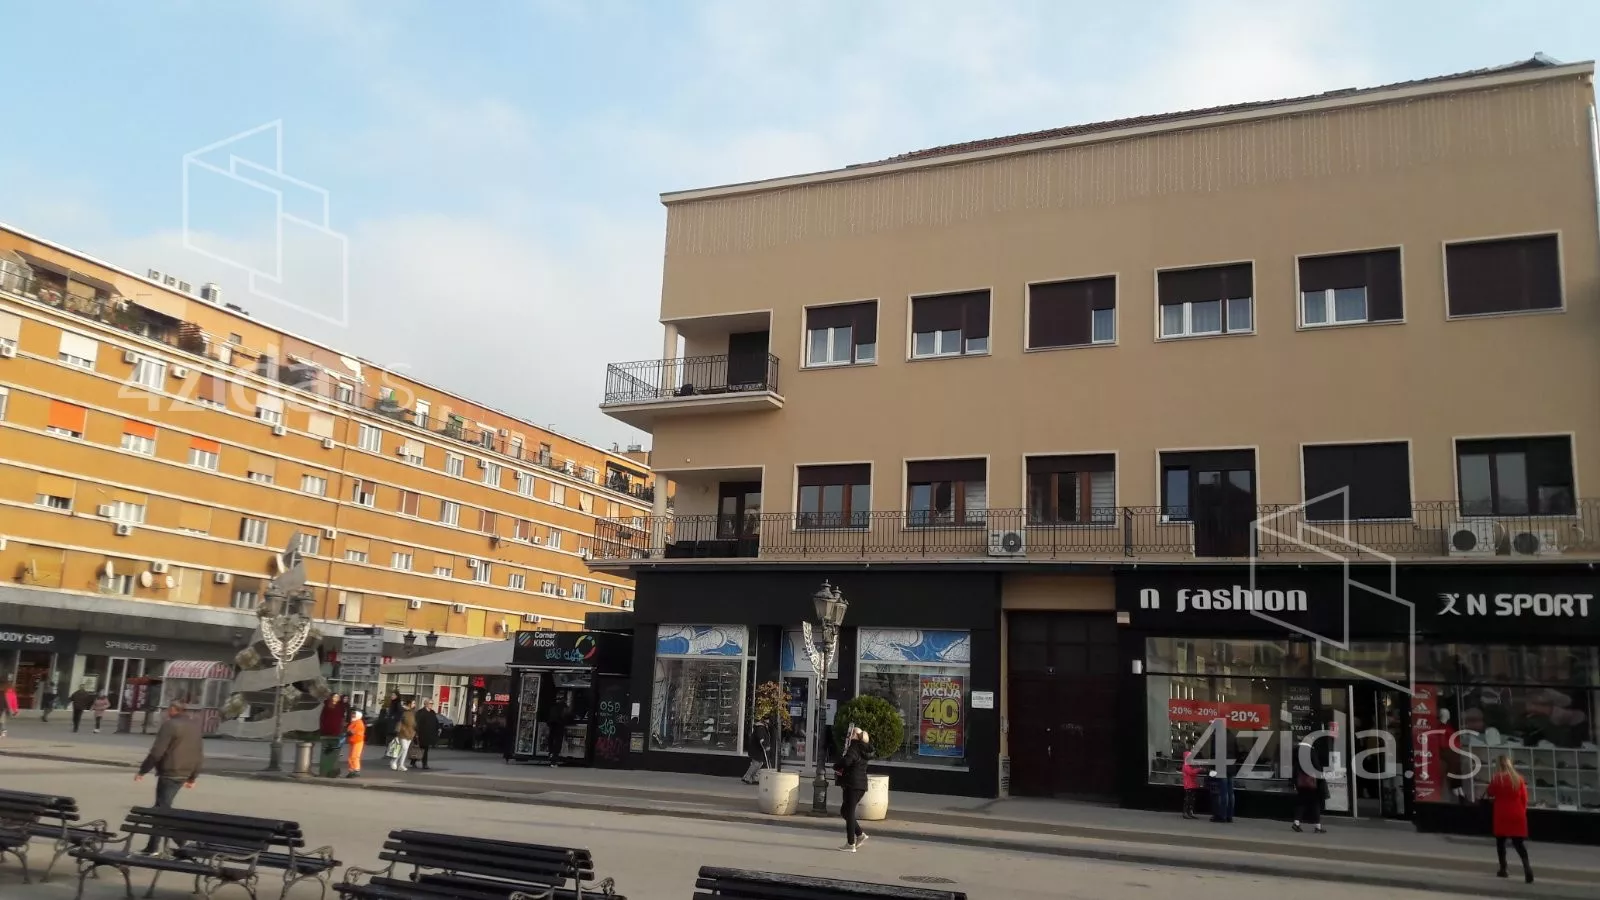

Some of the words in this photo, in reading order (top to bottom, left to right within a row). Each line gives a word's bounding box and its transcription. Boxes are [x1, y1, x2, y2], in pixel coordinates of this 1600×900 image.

[1466, 593, 1487, 616] N
[1494, 593, 1594, 617] SPORT
[25, 633, 55, 645] SHOP
[534, 631, 556, 639] Corner
[105, 640, 158, 652] SPRINGFIELD
[533, 639, 555, 647] KIOSK
[922, 688, 961, 698] AKCIJA
[1168, 706, 1192, 715] -20%
[1195, 708, 1218, 716] -20%
[1225, 711, 1260, 723] -20%
